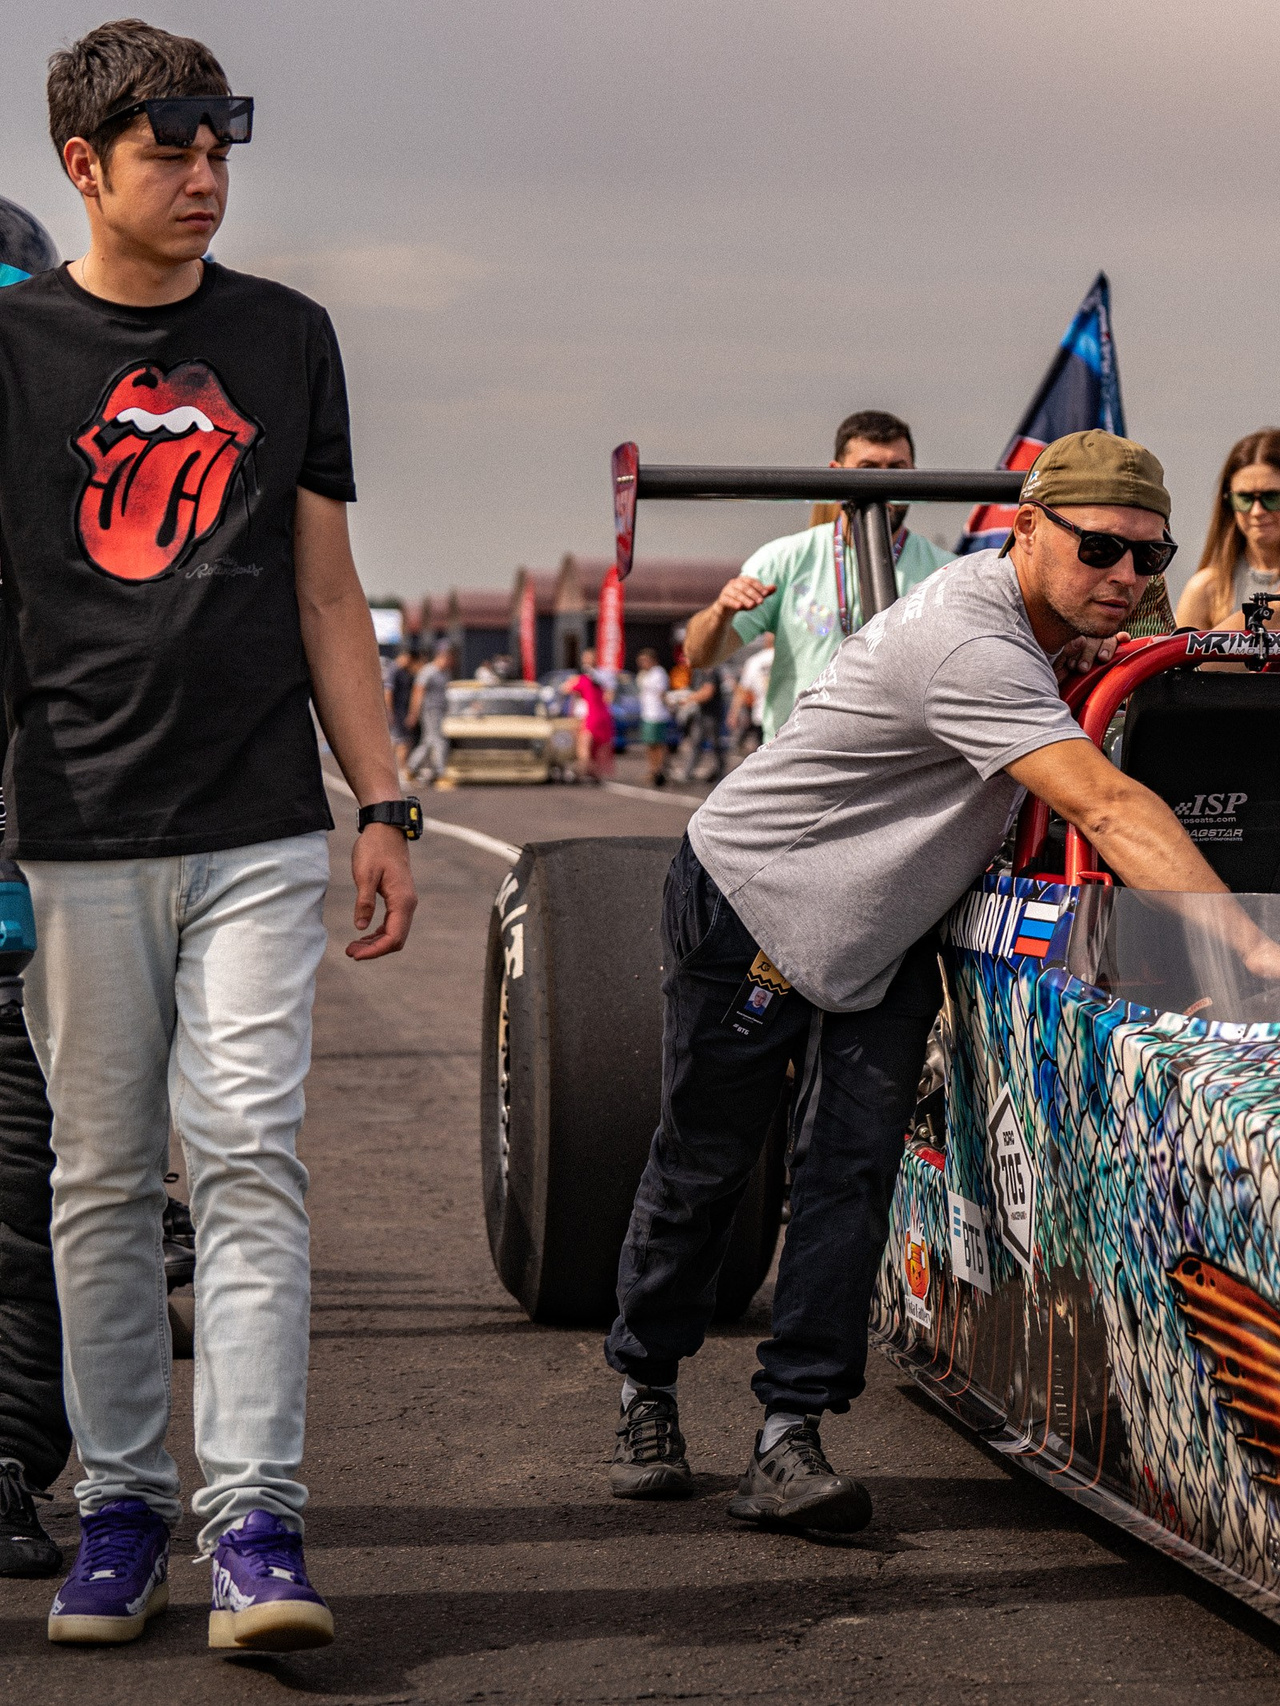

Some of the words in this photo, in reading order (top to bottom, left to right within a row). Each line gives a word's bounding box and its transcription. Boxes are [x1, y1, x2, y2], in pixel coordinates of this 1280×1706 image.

[1190, 792, 1249, 816] ISP
[1180, 816, 1237, 825] spseats.com
[1187, 828, 1244, 838] AGSTAR
[1000, 1152, 1026, 1206] 705
[962, 1223, 984, 1276] ВТБ
